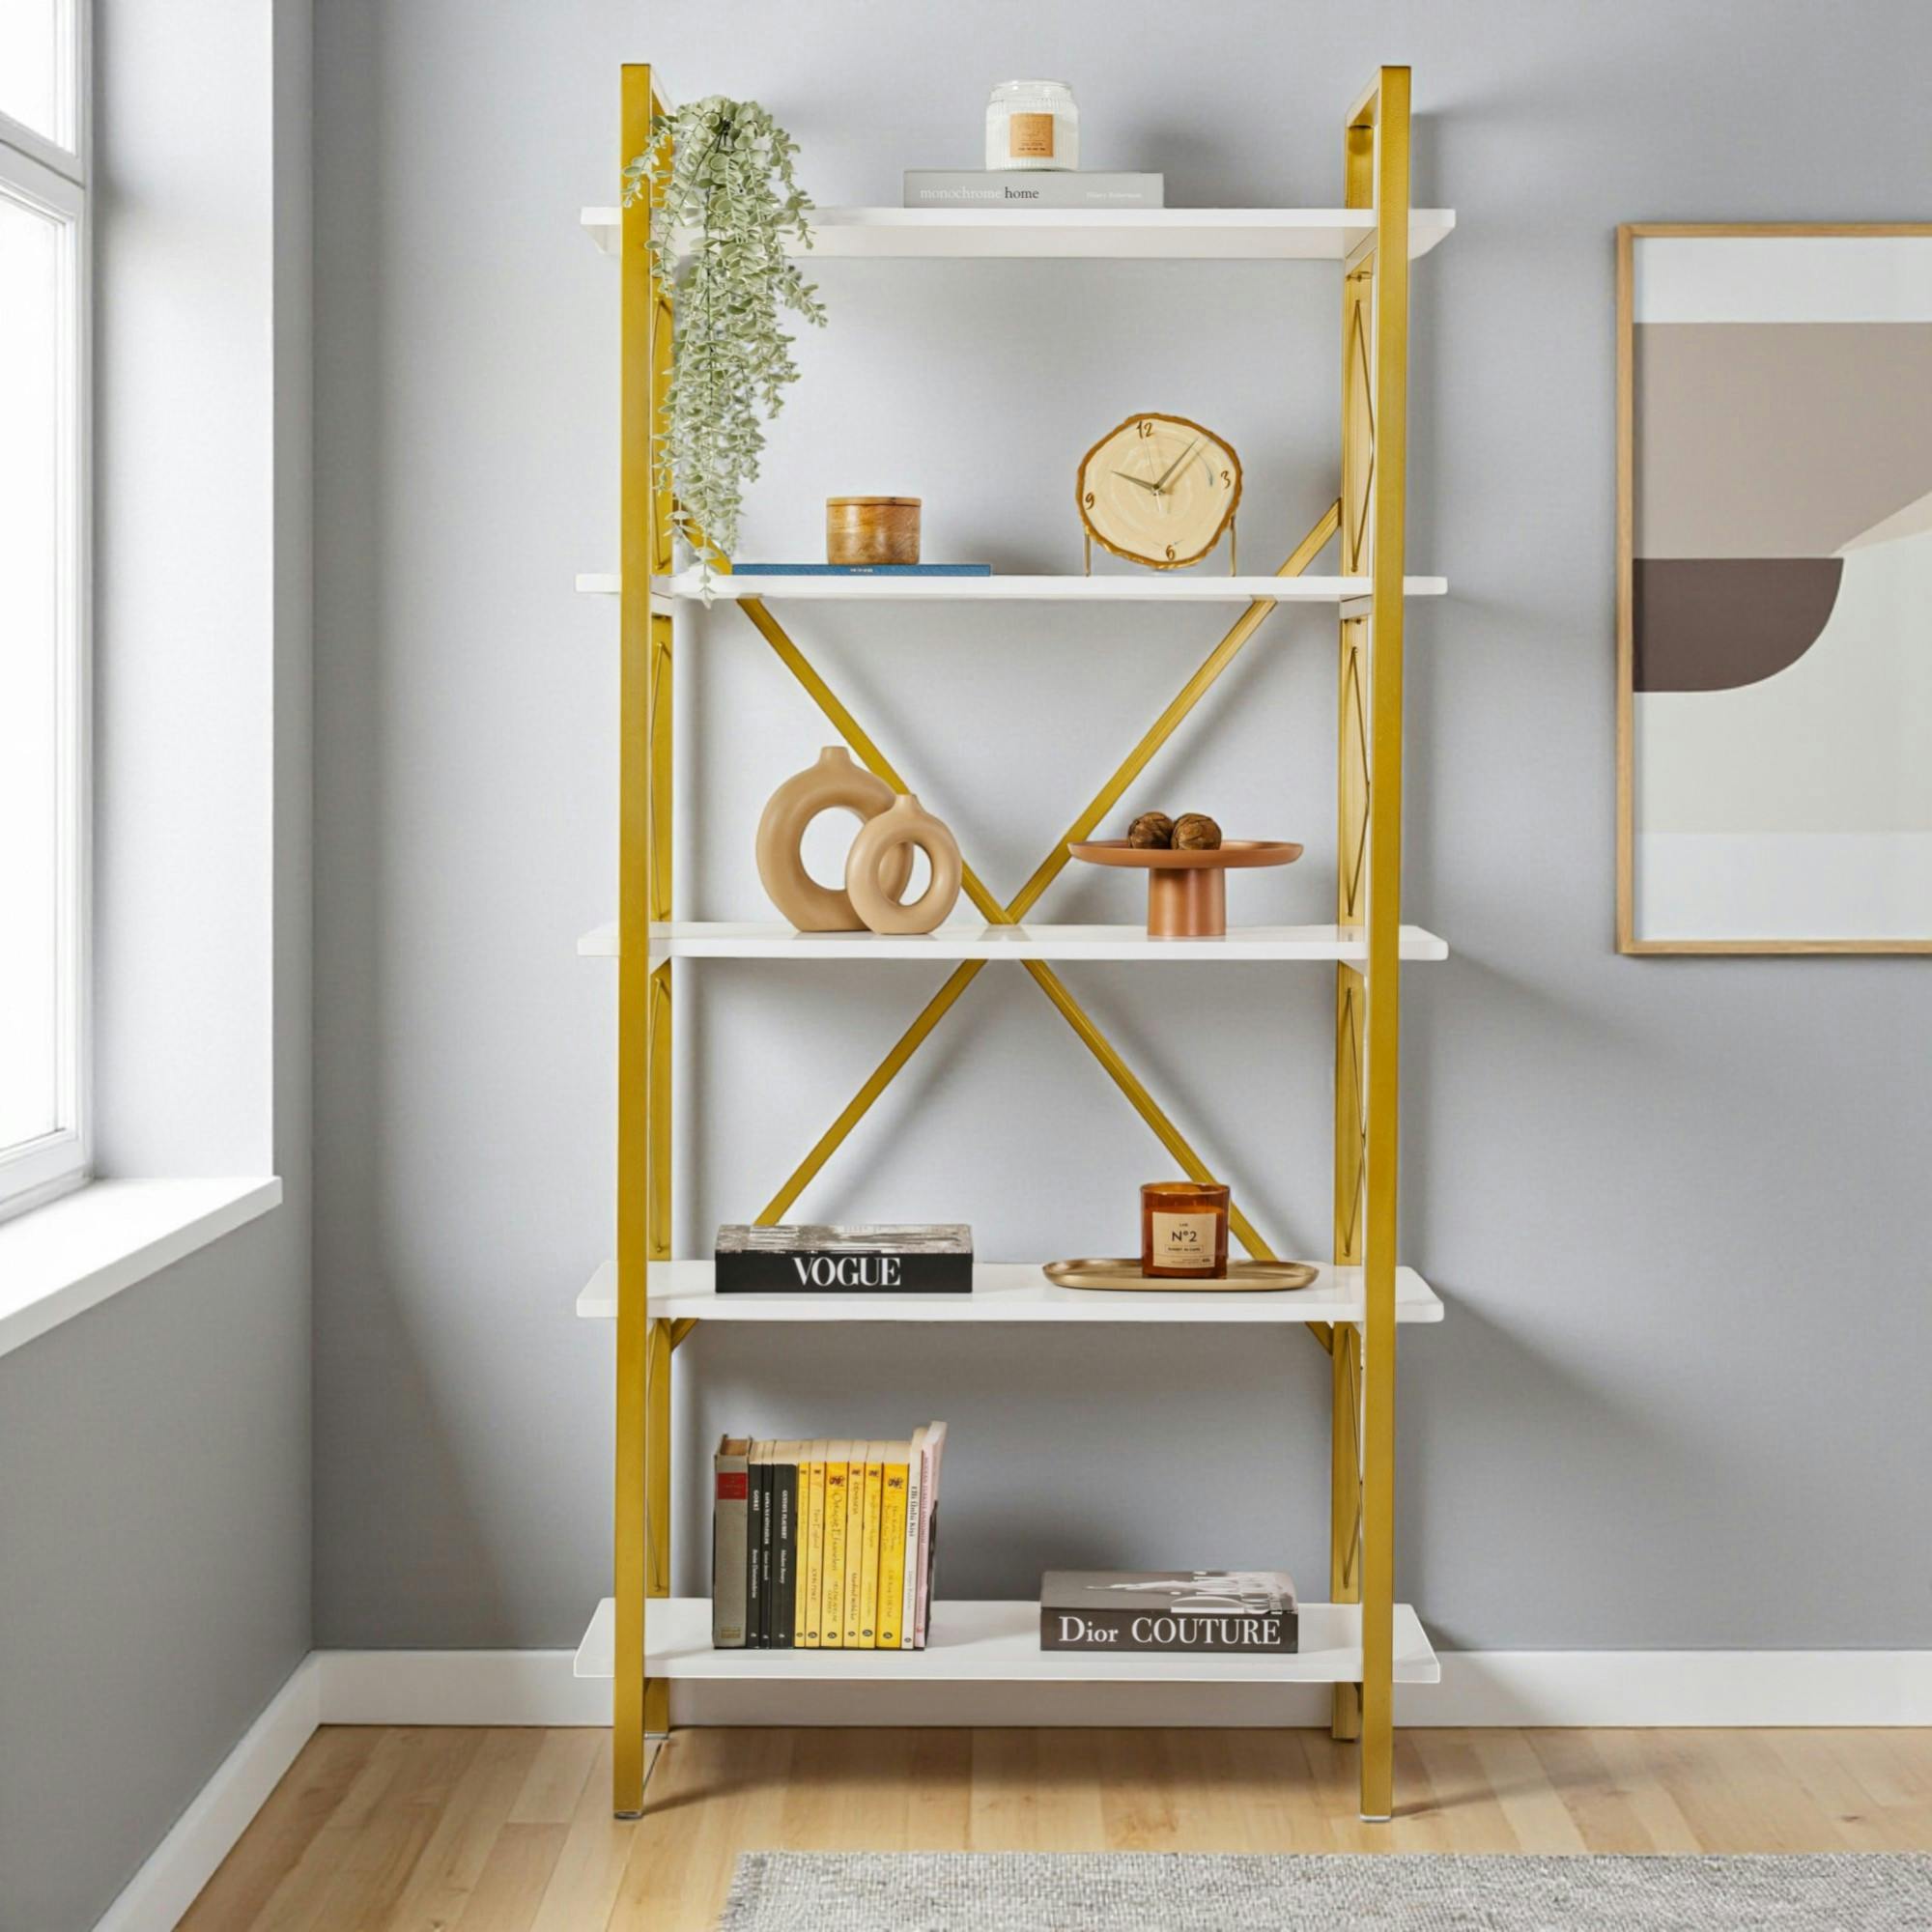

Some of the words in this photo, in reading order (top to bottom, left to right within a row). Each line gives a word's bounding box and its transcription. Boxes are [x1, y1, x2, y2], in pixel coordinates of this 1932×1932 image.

[920, 185, 1002, 200] monochrome
[1004, 185, 1040, 200] home
[1136, 419, 1154, 440] 12
[1220, 469, 1232, 490] 3
[1084, 492, 1095, 511] 9
[1165, 544, 1176, 561] 6
[792, 1256, 902, 1287] VOGUE
[1058, 1616, 1120, 1643] Dior
[1130, 1616, 1282, 1645] COUTURE
